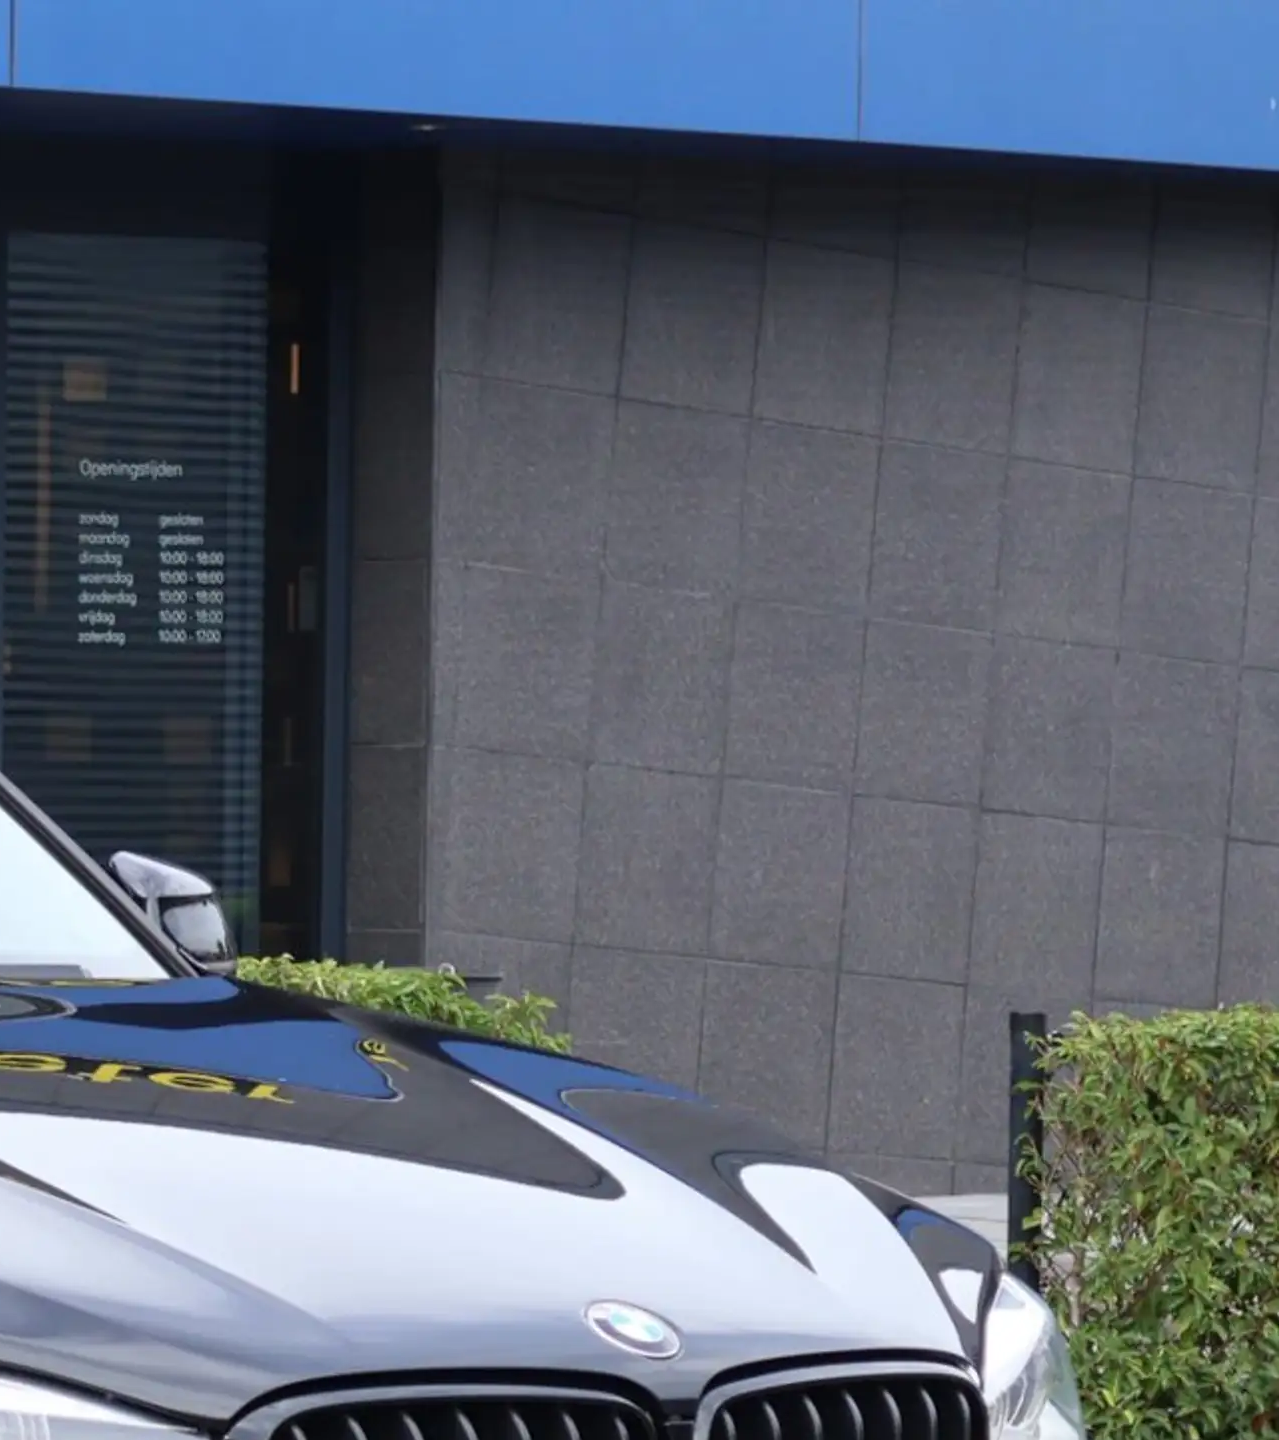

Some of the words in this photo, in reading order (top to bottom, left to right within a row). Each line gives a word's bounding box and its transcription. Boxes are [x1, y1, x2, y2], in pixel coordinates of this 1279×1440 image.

[78, 458, 183, 481] Openingstijden
[78, 511, 119, 528] zondag
[78, 531, 130, 548] maandag
[78, 550, 123, 567] dinsdag
[78, 570, 134, 587] woensdag
[78, 589, 137, 607] donderdag
[78, 609, 115, 626] vrijdag
[78, 628, 126, 646] zaterdag
